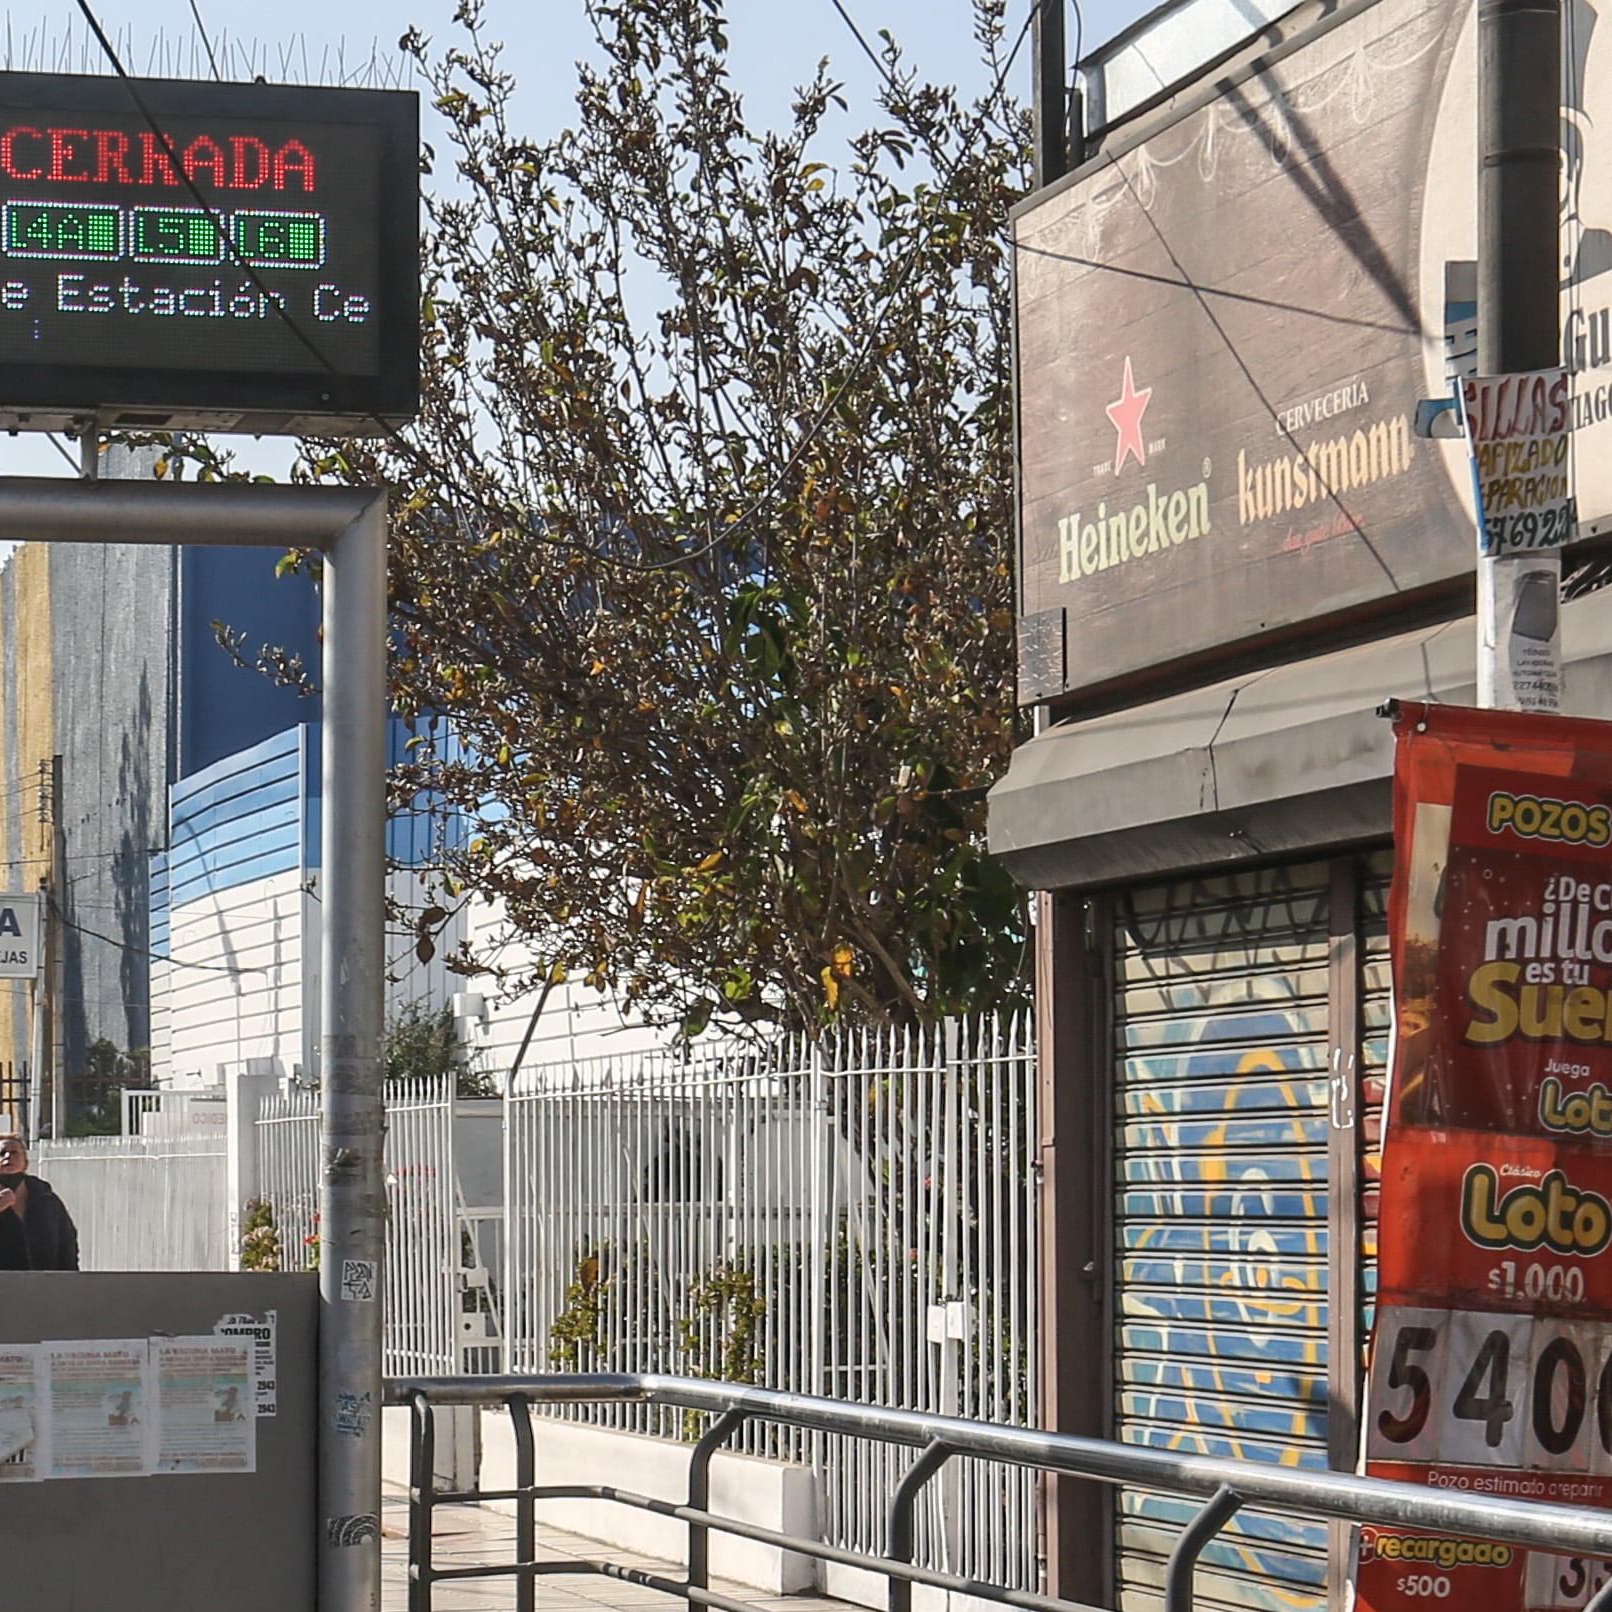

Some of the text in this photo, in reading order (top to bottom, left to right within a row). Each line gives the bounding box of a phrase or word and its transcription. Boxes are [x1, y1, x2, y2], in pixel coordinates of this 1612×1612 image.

[0, 125, 315, 193] CERRADA
[56, 274, 287, 320] Estación
[313, 286, 371, 323] Ce
[1276, 375, 1370, 436] CERVECERÍA
[1238, 414, 1410, 527] kunstmann
[1058, 482, 1212, 585] Heineken
[1490, 797, 1608, 845] POZOS
[1543, 875, 1591, 906] ¿De
[1524, 957, 1590, 987] es tu
[1544, 1057, 1591, 1081] Juega
[1467, 1169, 1609, 1250] Loto
[1427, 1470, 1469, 1489] Pozo
[1375, 1535, 1510, 1569] recargado
[1396, 1574, 1452, 1598] $500
